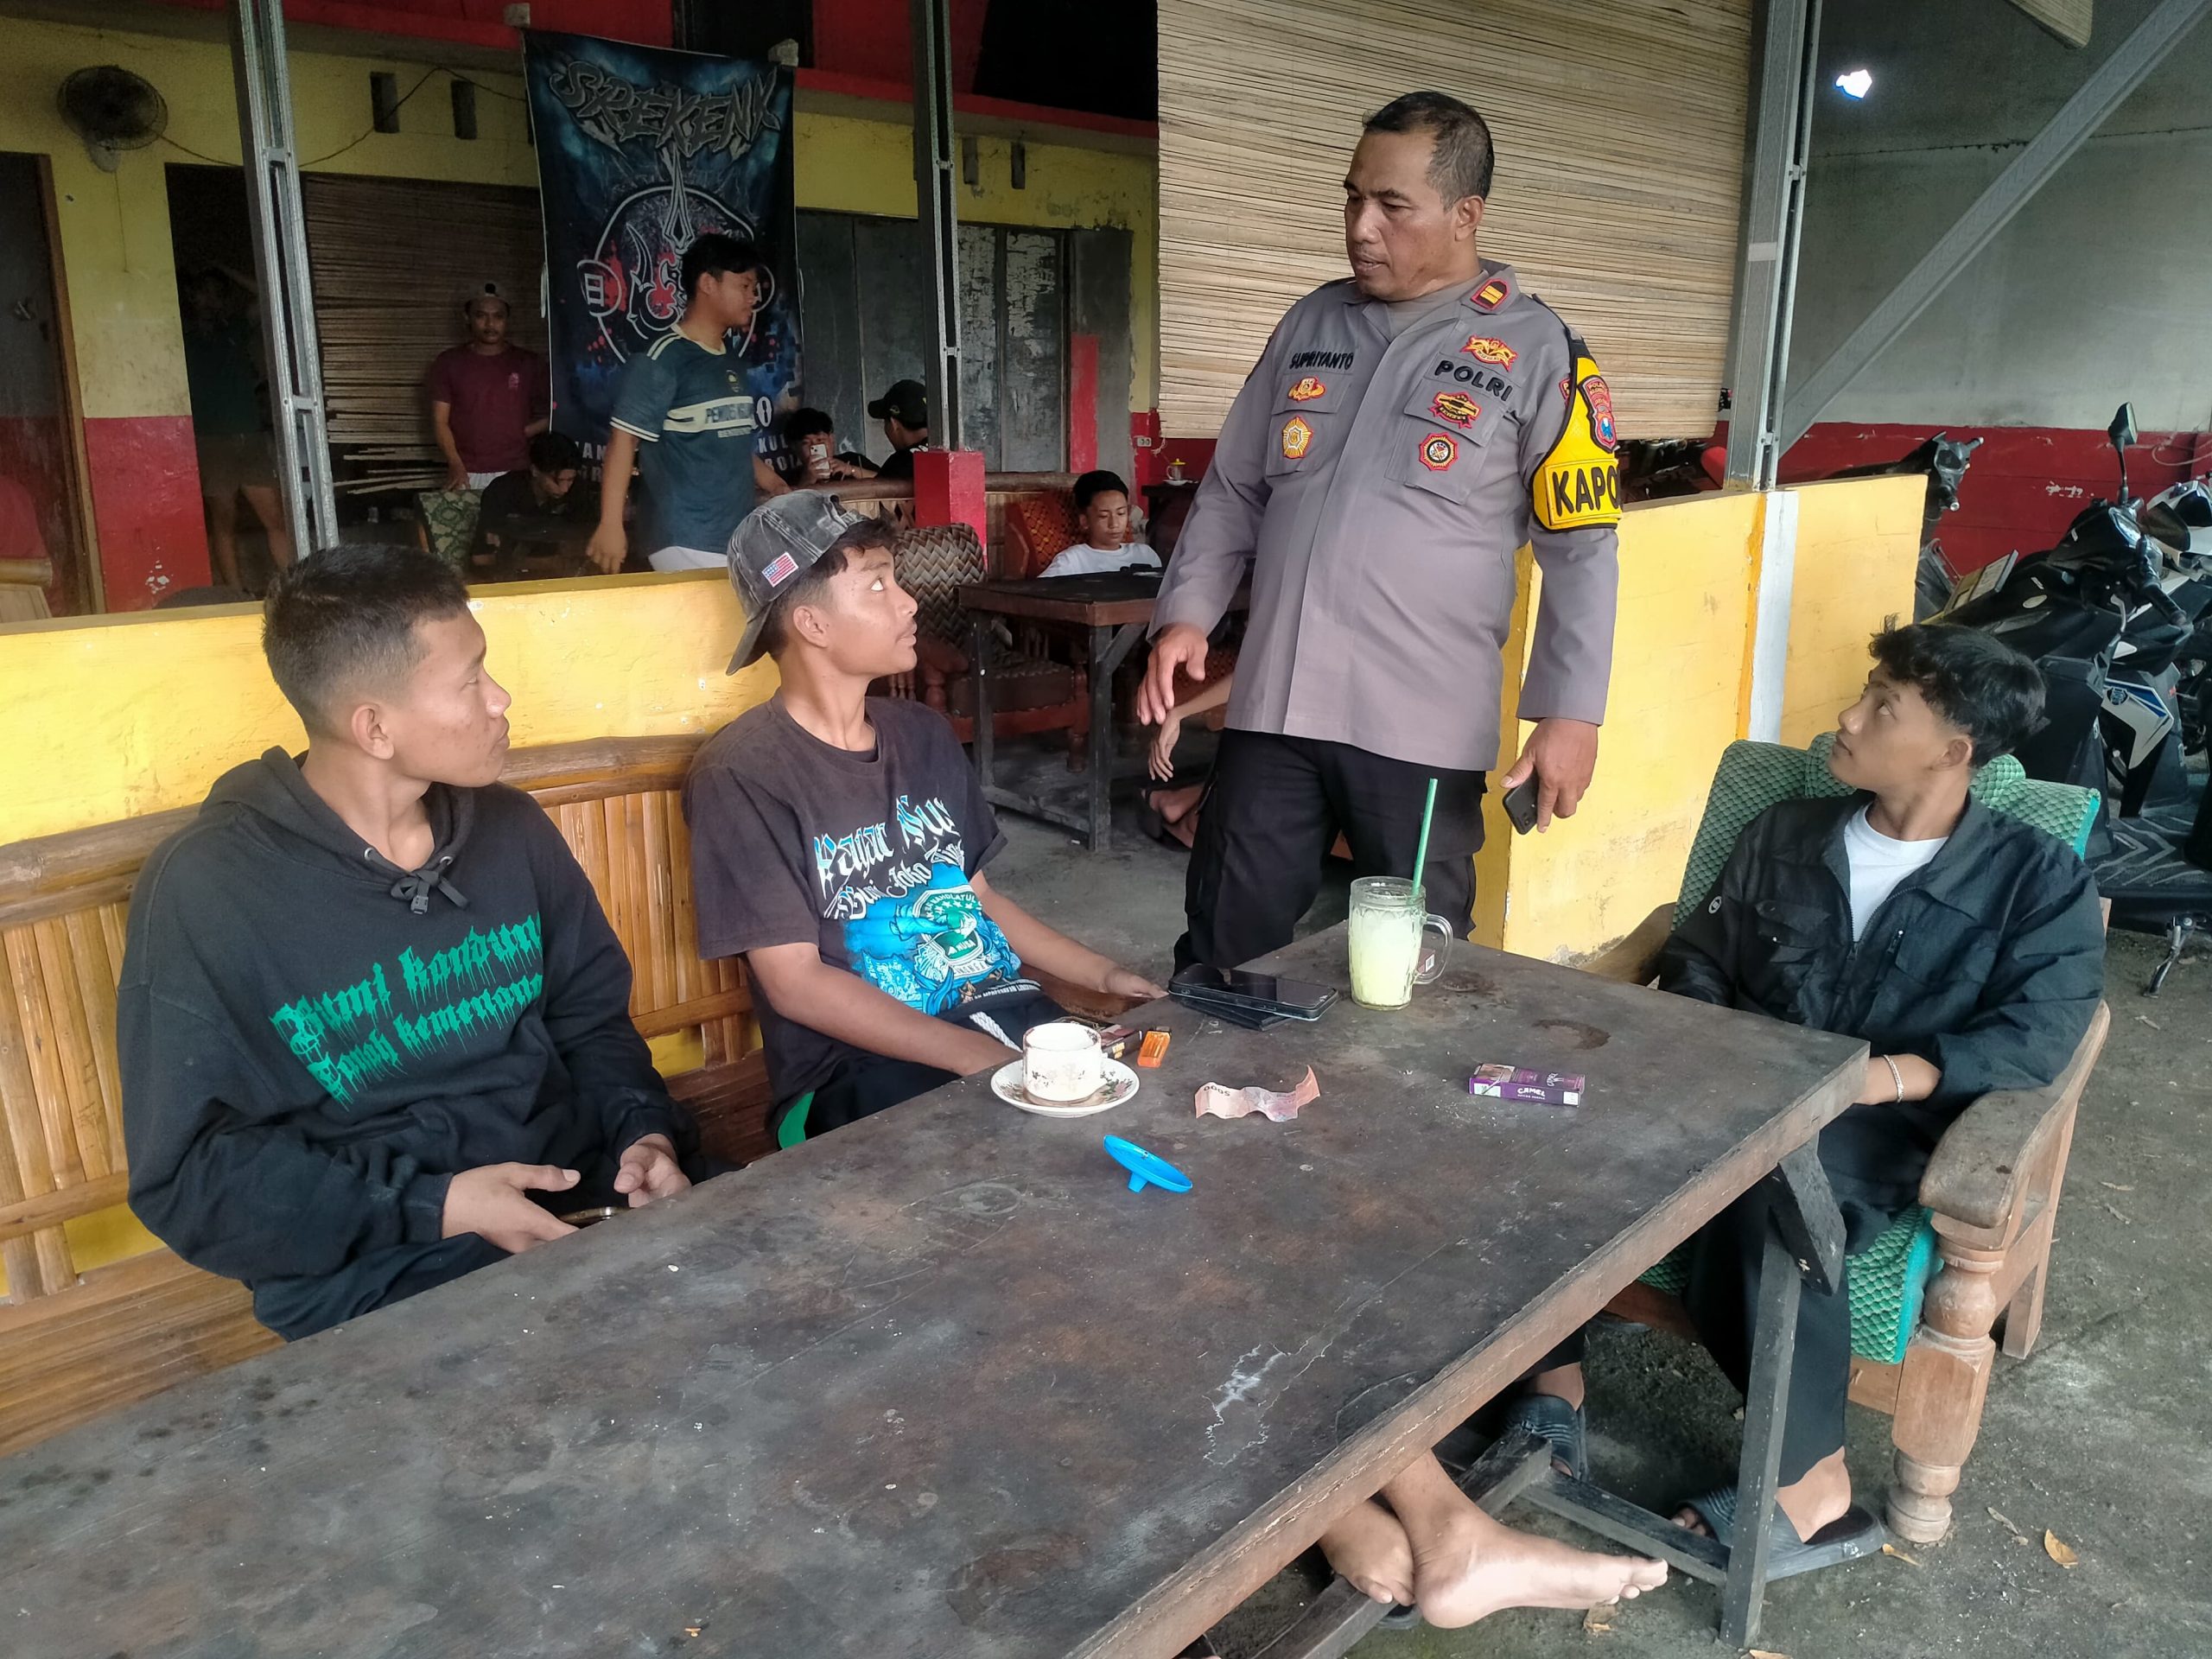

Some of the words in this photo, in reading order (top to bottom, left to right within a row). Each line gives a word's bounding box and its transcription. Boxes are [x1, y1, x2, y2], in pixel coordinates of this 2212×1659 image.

[1289, 351, 1354, 370] SUPRIYANTO
[1434, 359, 1513, 402] POLRI
[1552, 465, 1622, 517] KAPO
[1516, 1087, 1546, 1097] CAMEL
